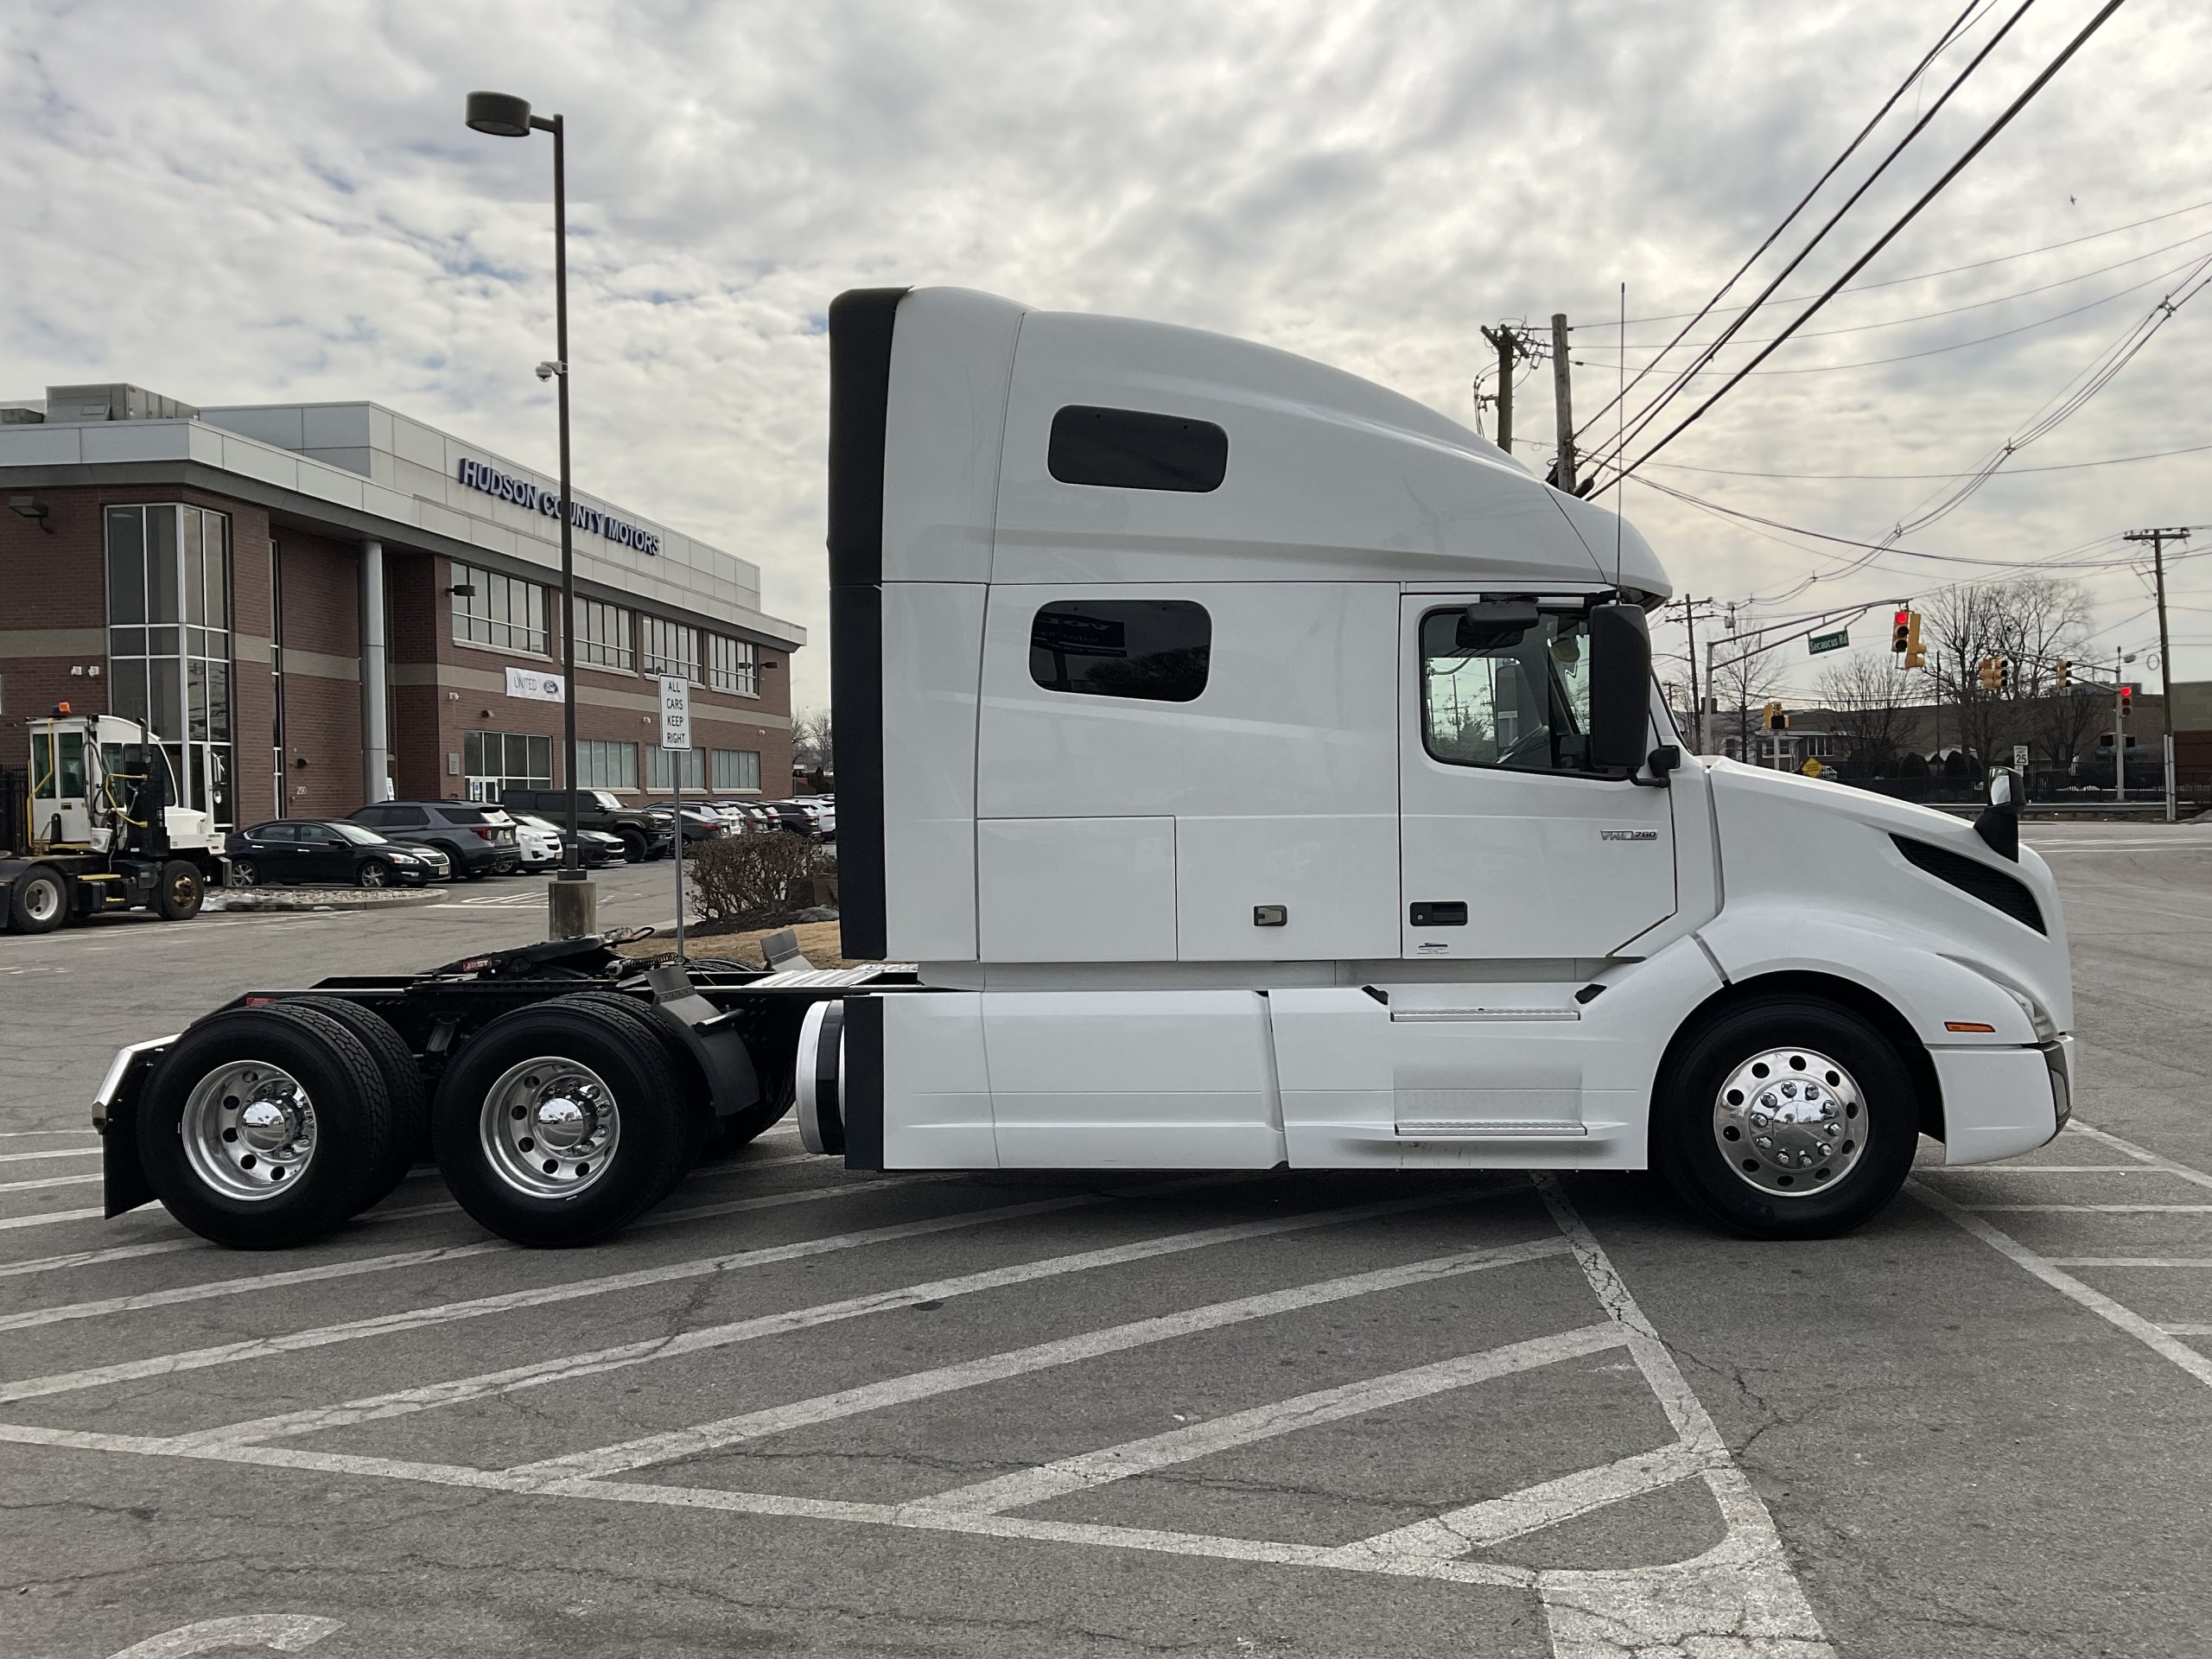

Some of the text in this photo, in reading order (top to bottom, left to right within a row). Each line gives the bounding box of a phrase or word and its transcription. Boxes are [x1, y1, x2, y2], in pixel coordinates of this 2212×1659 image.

[459, 458, 538, 508] HUDSON
[605, 517, 660, 555] MOTORS
[1810, 634, 1847, 652] Secaucus Rd
[668, 681, 681, 692] ALL
[666, 698, 683, 710] CARS
[667, 715, 683, 727] KEEP
[667, 733, 685, 744] RIGHT
[2016, 754, 2026, 764] 25
